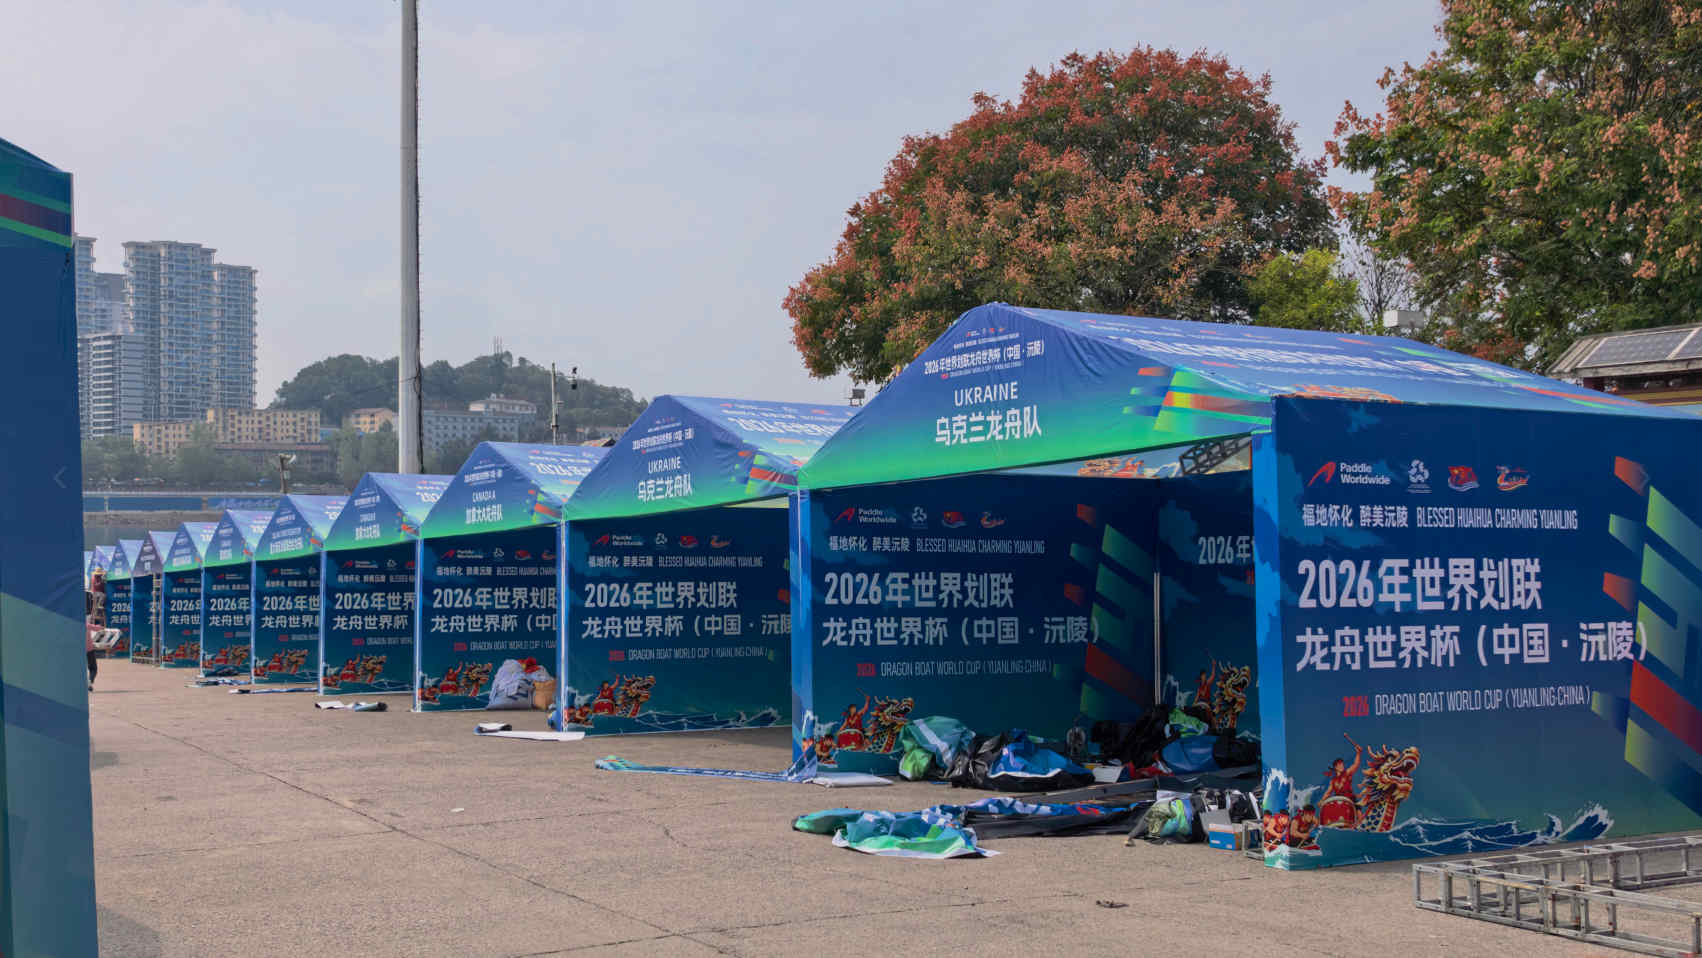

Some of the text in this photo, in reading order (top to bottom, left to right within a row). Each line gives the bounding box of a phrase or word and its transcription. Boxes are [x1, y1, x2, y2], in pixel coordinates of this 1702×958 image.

[954, 381, 1018, 406] UKRAINE
[936, 404, 1042, 446] 乌克兰龙舟队
[648, 456, 681, 474] UKRAINE
[1340, 463, 1372, 475] Paddle
[638, 472, 693, 502] 乌克兰龙舟队
[1340, 473, 1392, 486] Worldwide
[1302, 504, 1578, 530] 福地怀化 醉美沅陵 BLESSED HUAIHUA CHARMING YUANLING
[916, 538, 946, 554] BLESSED
[948, 539, 976, 554] HUAIHUA
[978, 539, 1013, 555] CHARMING
[1014, 540, 1045, 555] YUANLING
[1198, 536, 1255, 565] 2026年
[584, 581, 738, 610] 2026年世界划联
[823, 572, 1015, 610] 2026年世界划联
[1297, 556, 1542, 613] 2026年世界划联
[335, 592, 415, 611] 2026年世界
[431, 614, 557, 633] 龙舟世界杯（中
[880, 662, 911, 678] DRAGON
[913, 661, 935, 677] BOAT
[936, 660, 963, 676] WORLD
[965, 659, 981, 675] CUP
[1342, 696, 1370, 717] 2026
[1375, 693, 1416, 716] DRAGON
[1419, 691, 1445, 714] BOAT
[1448, 689, 1482, 712] WORLD
[1484, 687, 1503, 711] CUP
